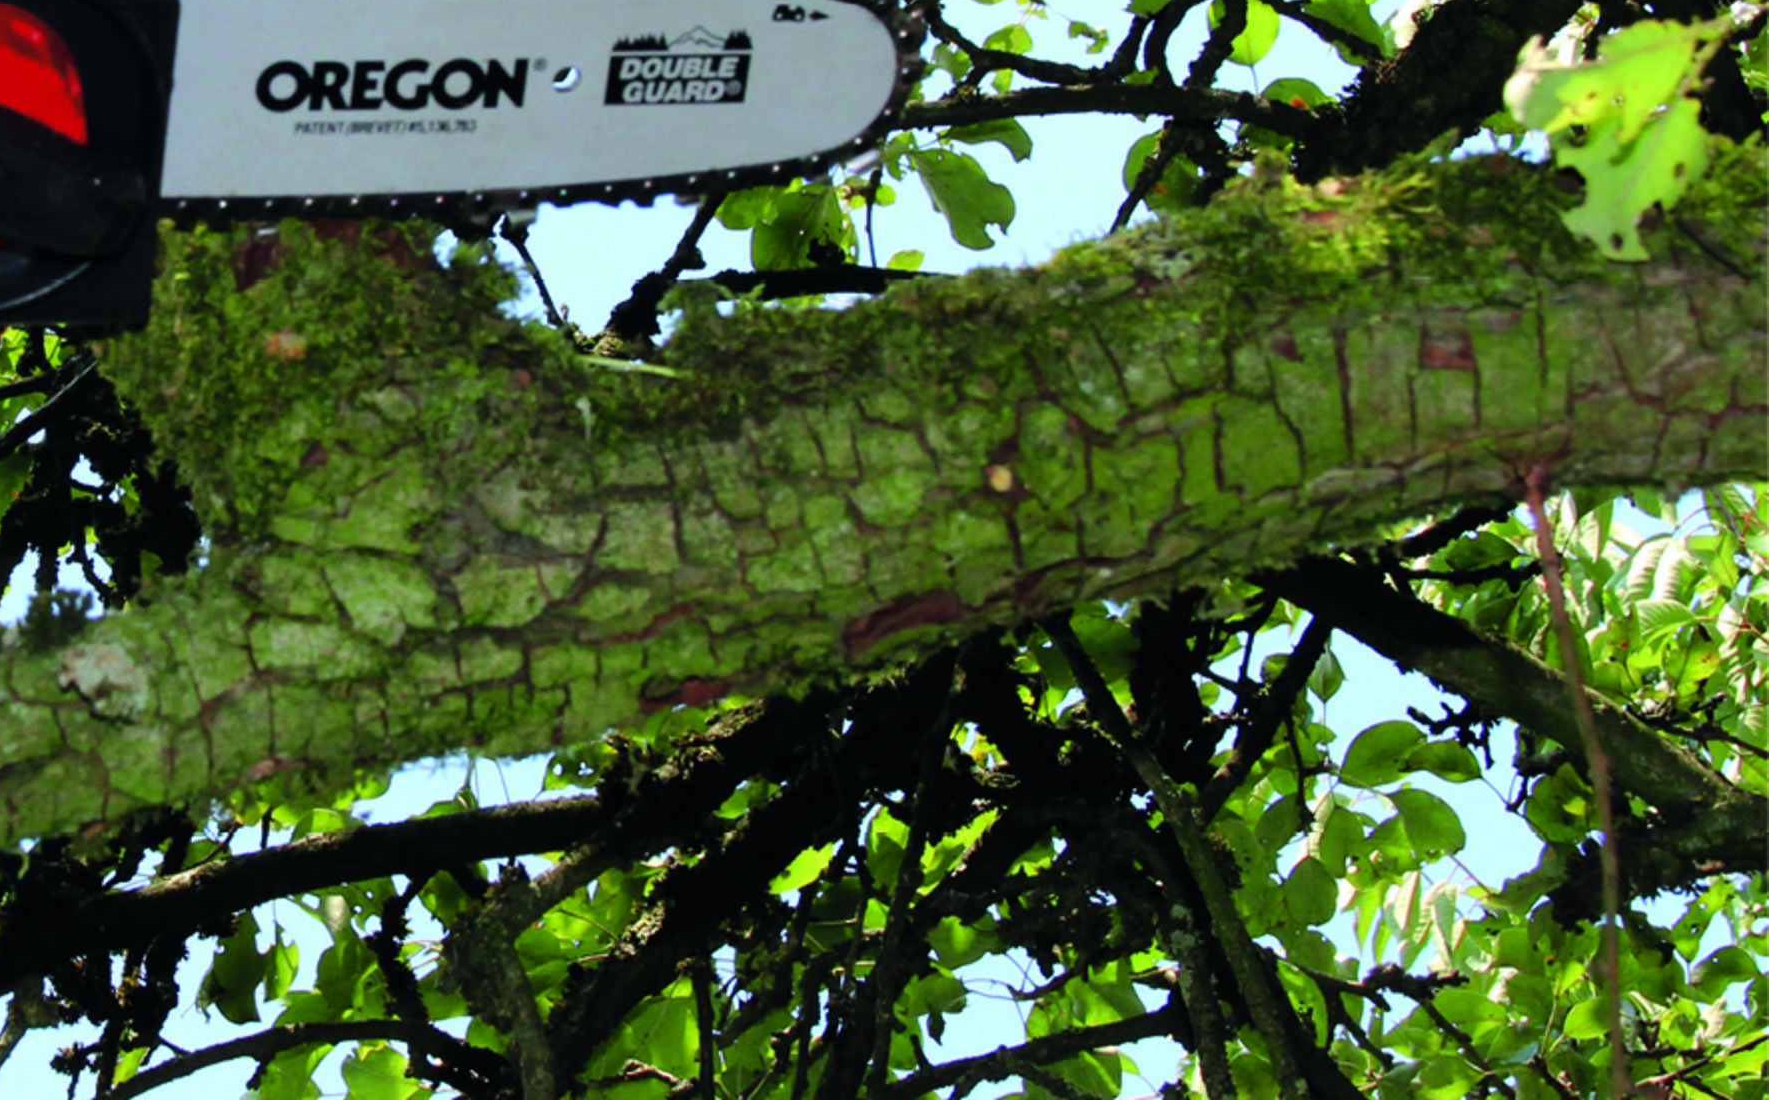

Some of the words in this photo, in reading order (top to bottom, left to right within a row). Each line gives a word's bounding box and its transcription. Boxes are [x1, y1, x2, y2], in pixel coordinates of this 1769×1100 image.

[619, 56, 739, 80] DOUBLE
[256, 58, 530, 113] OREGON
[294, 122, 345, 136] PATENT
